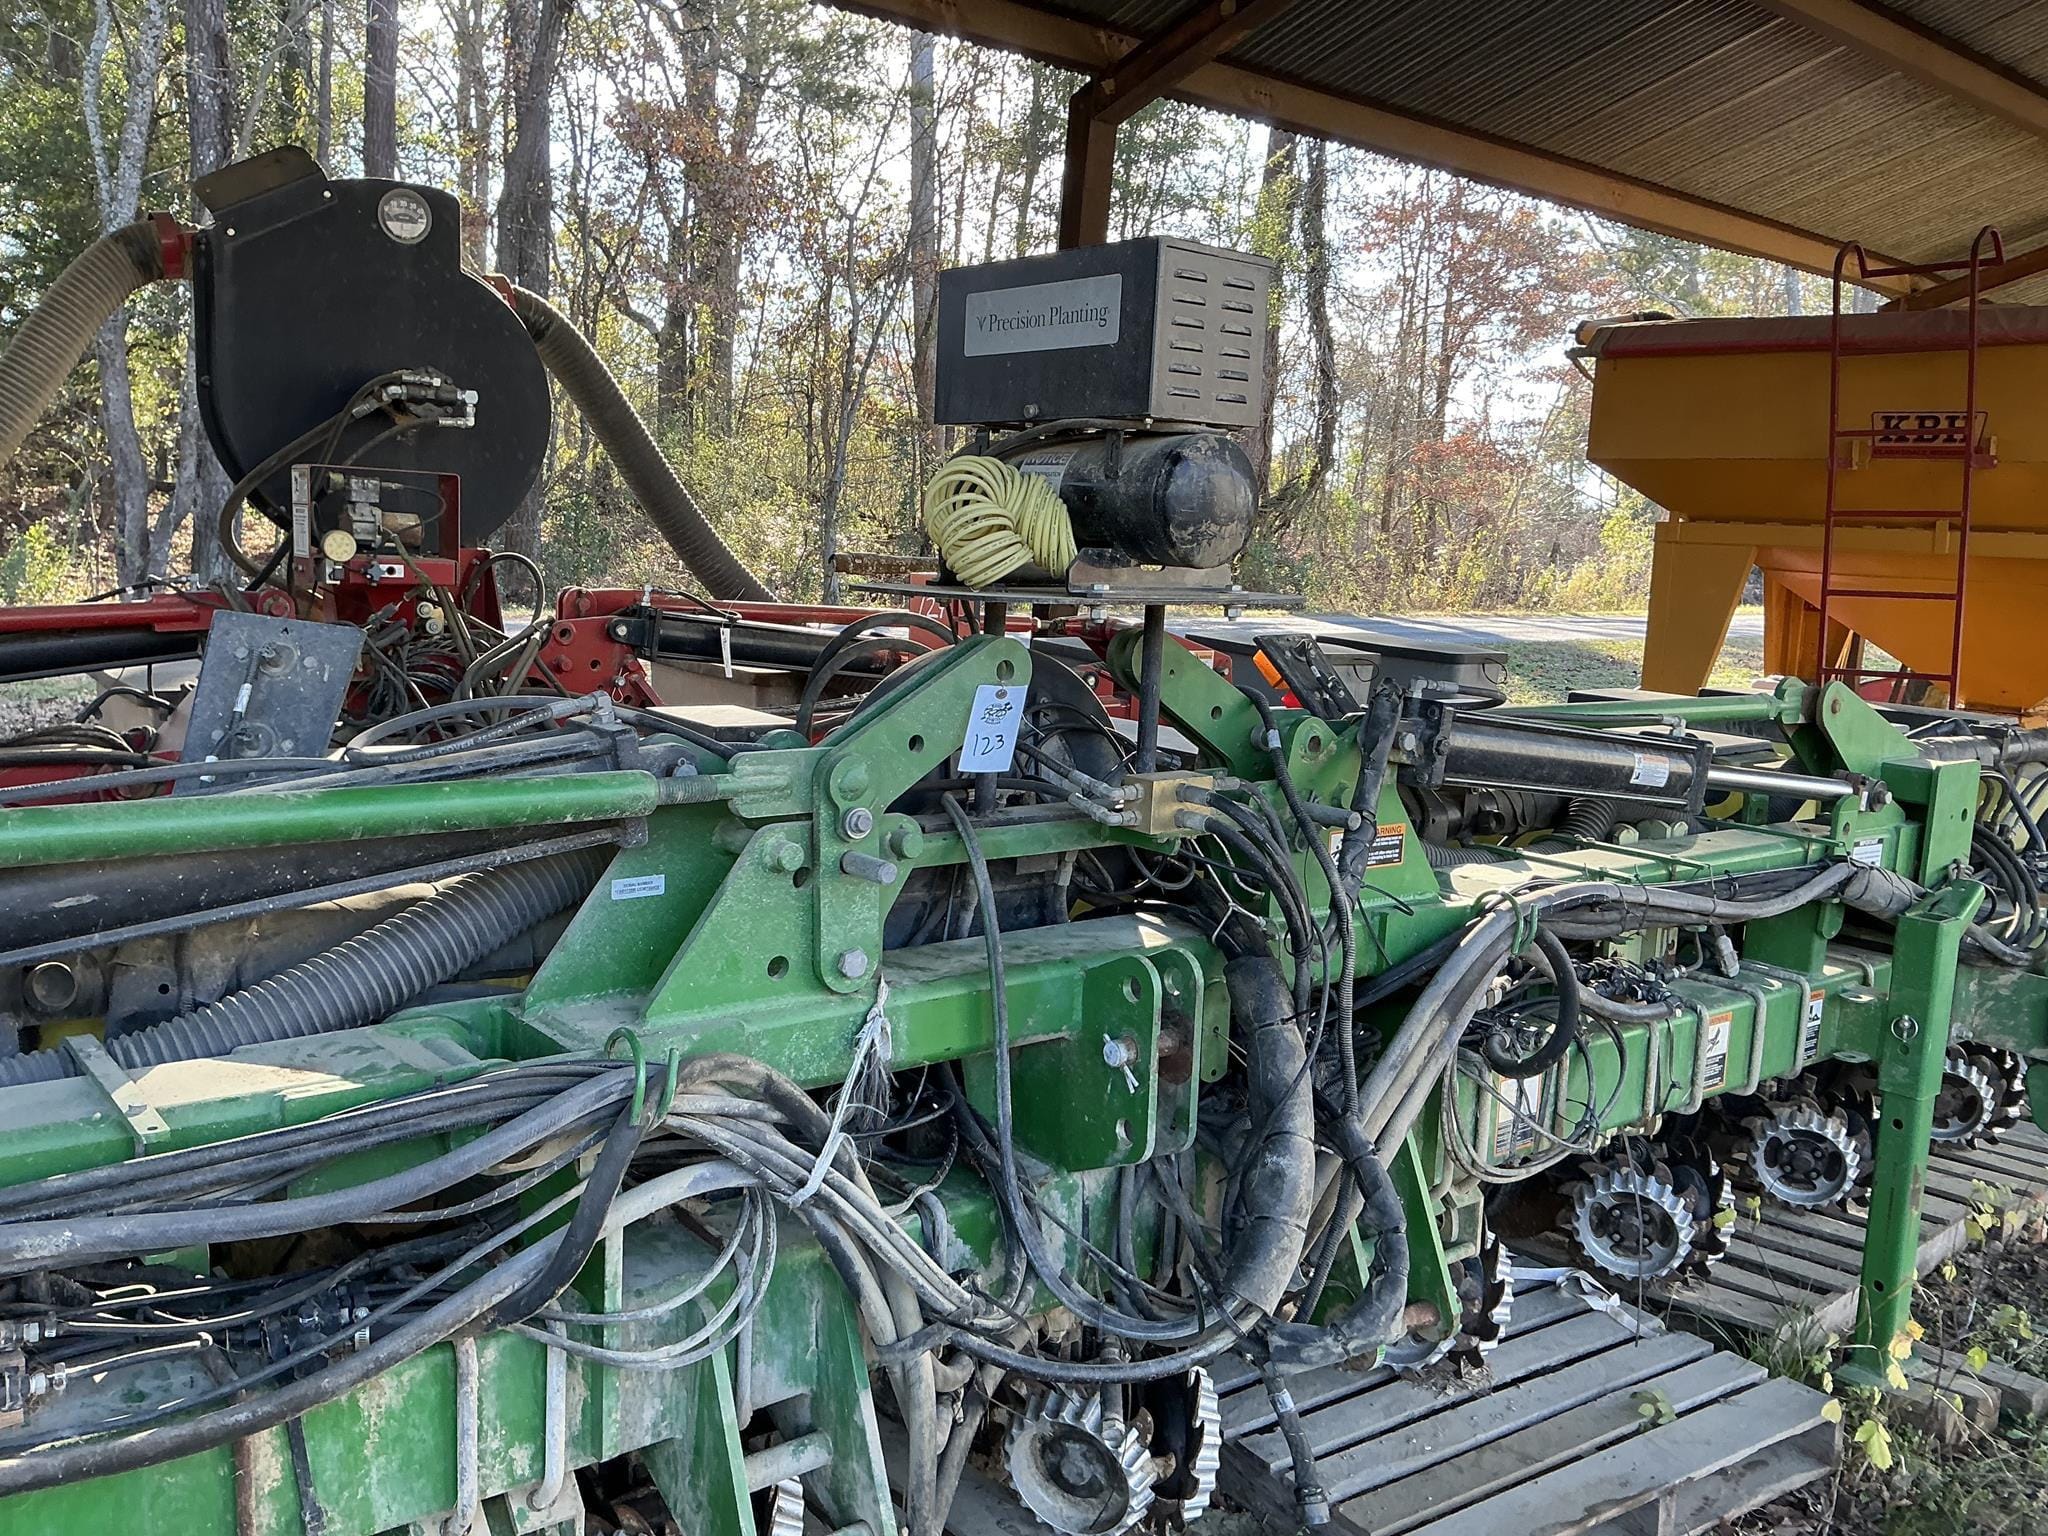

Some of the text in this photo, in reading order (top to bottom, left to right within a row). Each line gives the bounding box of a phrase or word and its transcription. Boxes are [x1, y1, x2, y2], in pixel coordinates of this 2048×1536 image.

[989, 302, 1109, 332] Precision Planting
[973, 734, 1005, 757] 123
